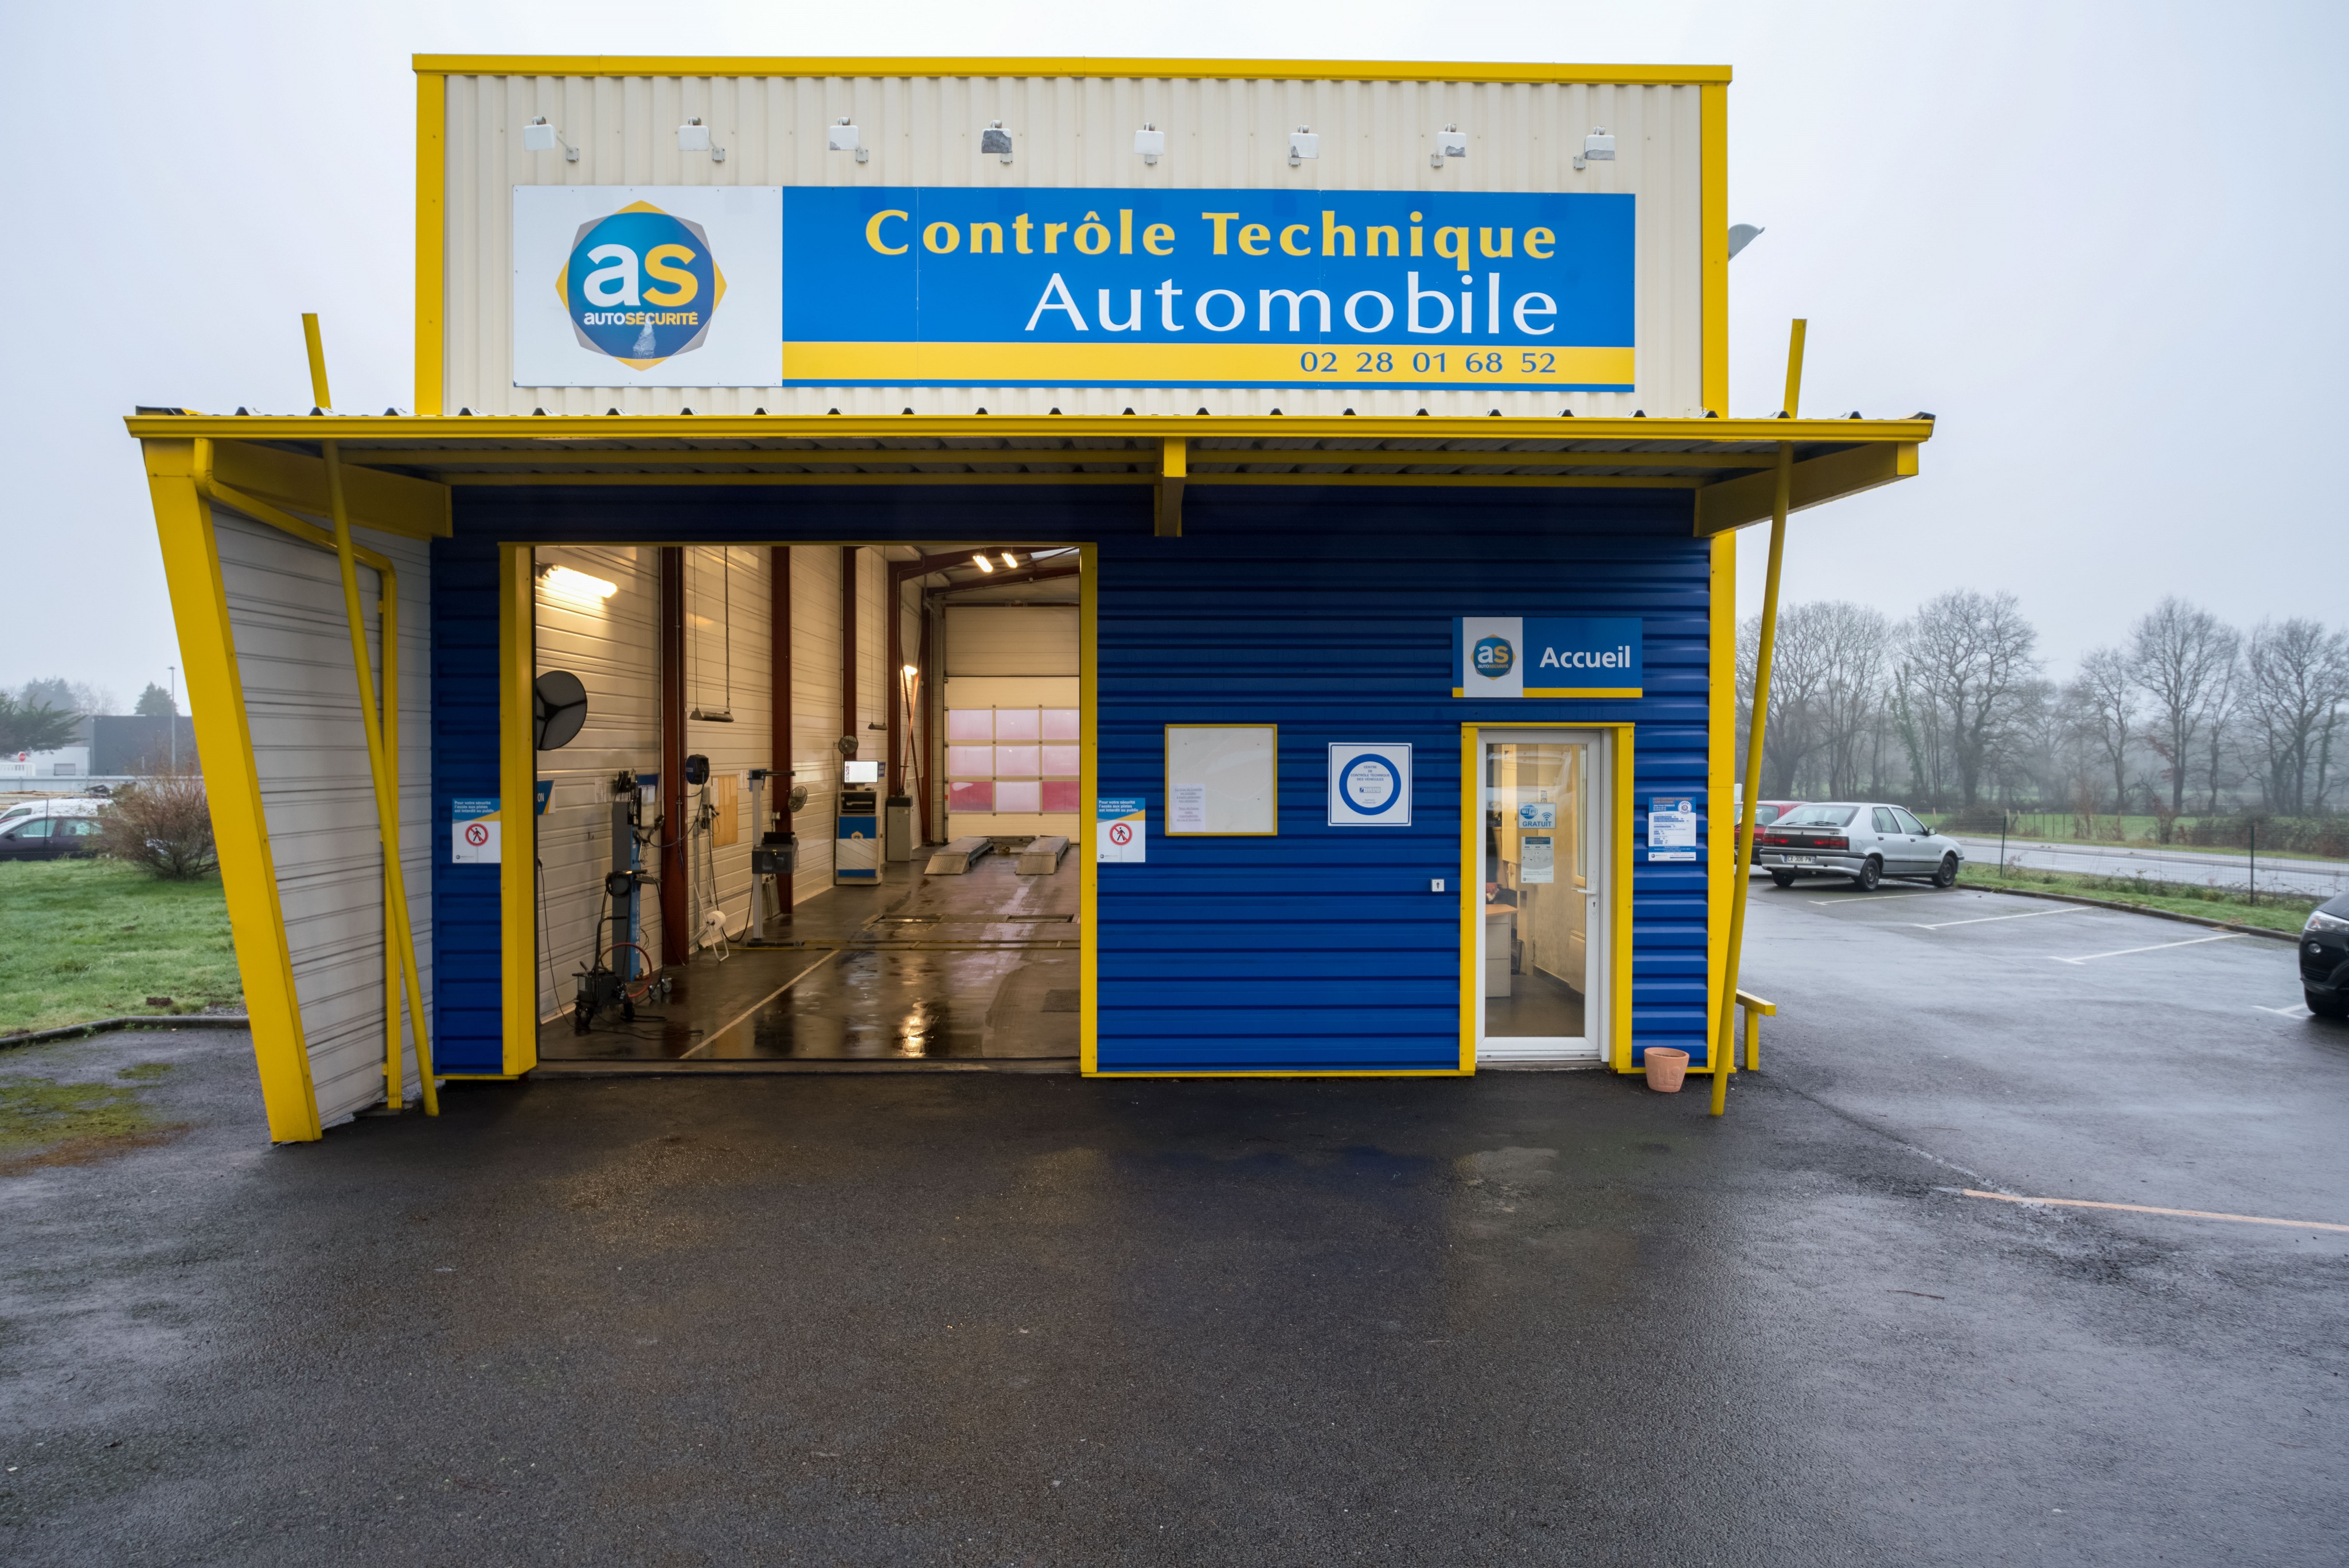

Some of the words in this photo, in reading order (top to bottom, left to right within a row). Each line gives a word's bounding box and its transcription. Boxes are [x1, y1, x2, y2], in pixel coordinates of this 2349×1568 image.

[865, 209, 1176, 256] Contrôle
[1201, 209, 1556, 272] Technique
[583, 243, 699, 307] as
[1024, 271, 1558, 336] Automobile
[1300, 352, 1337, 373] 02
[1356, 352, 1394, 373] 28
[1412, 352, 1447, 373] 01
[1465, 352, 1503, 374] 68
[1520, 352, 1556, 374] 52
[1477, 645, 1509, 664] as
[1539, 645, 1630, 668] Accueil
